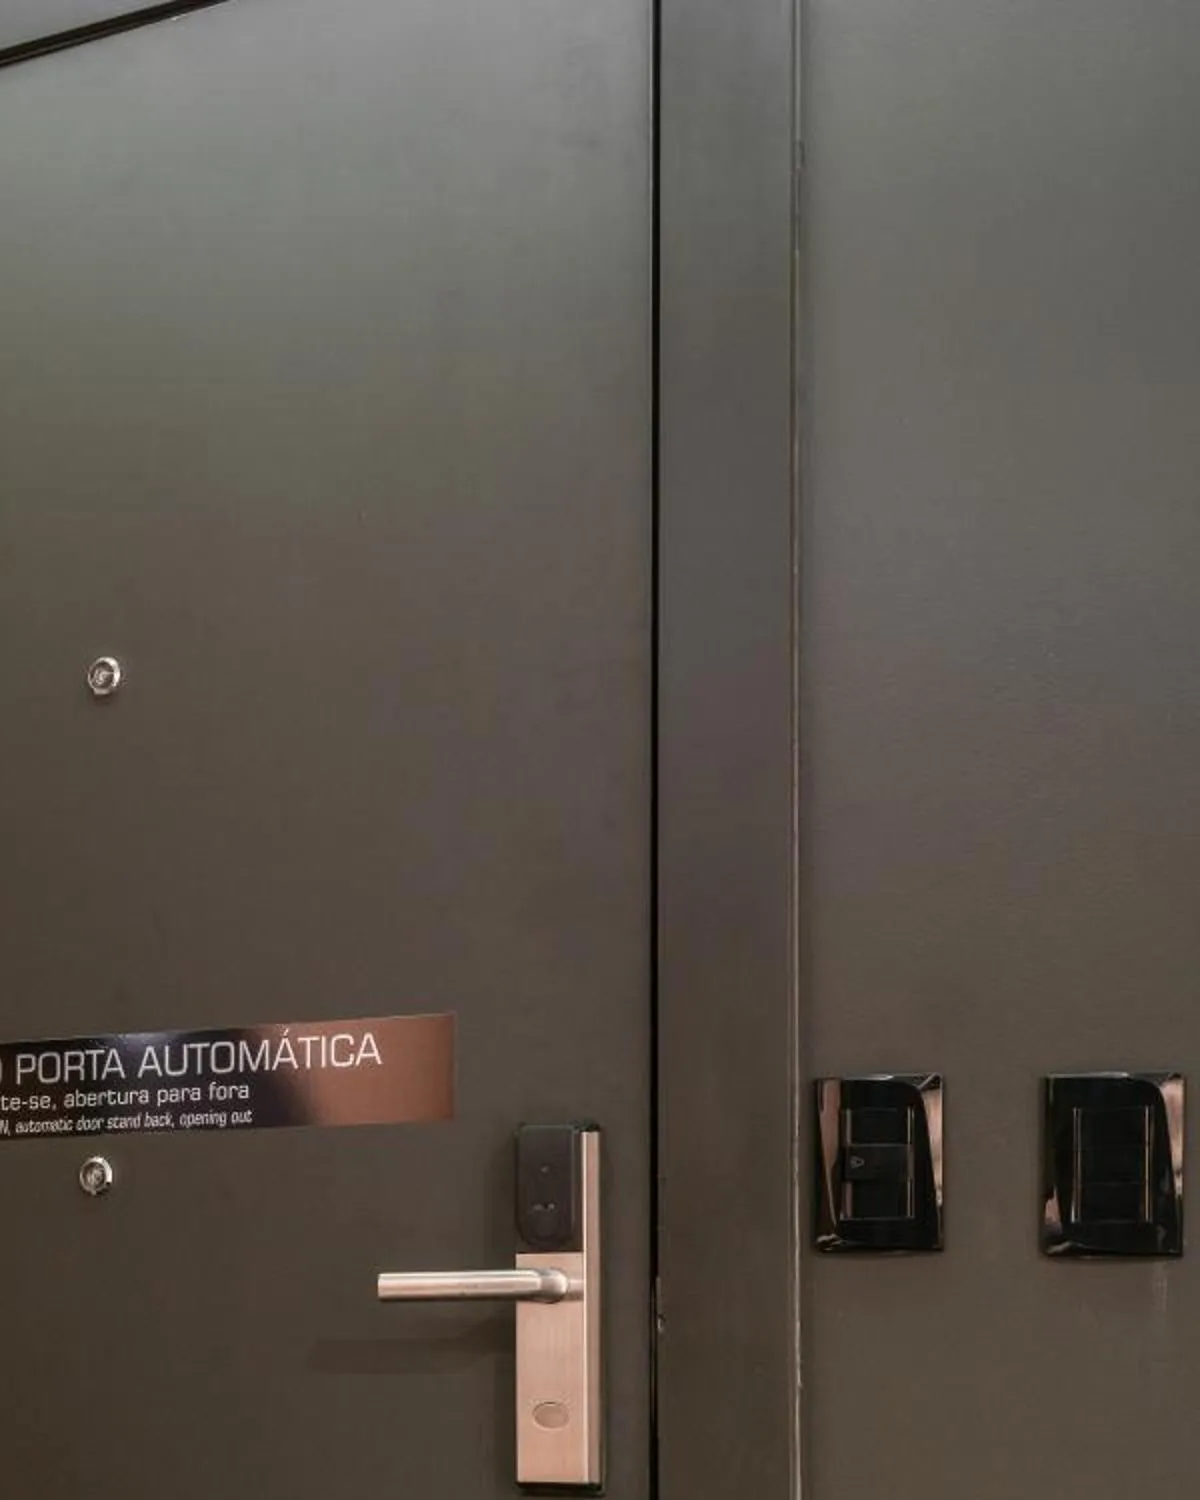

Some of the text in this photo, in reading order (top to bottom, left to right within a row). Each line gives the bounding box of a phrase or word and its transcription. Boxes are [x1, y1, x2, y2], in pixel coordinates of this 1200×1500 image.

[16, 1049, 126, 1085] PORTA
[137, 1028, 383, 1078] AUTOMÁTICA
[63, 1087, 150, 1108] abertura
[157, 1088, 201, 1107] para
[209, 1080, 250, 1101] fora
[15, 1117, 73, 1134] automatic
[76, 1115, 104, 1130] door
[106, 1112, 142, 1129] stand
[143, 1111, 176, 1129] back,
[179, 1110, 227, 1129] opening
[231, 1109, 253, 1124] out
